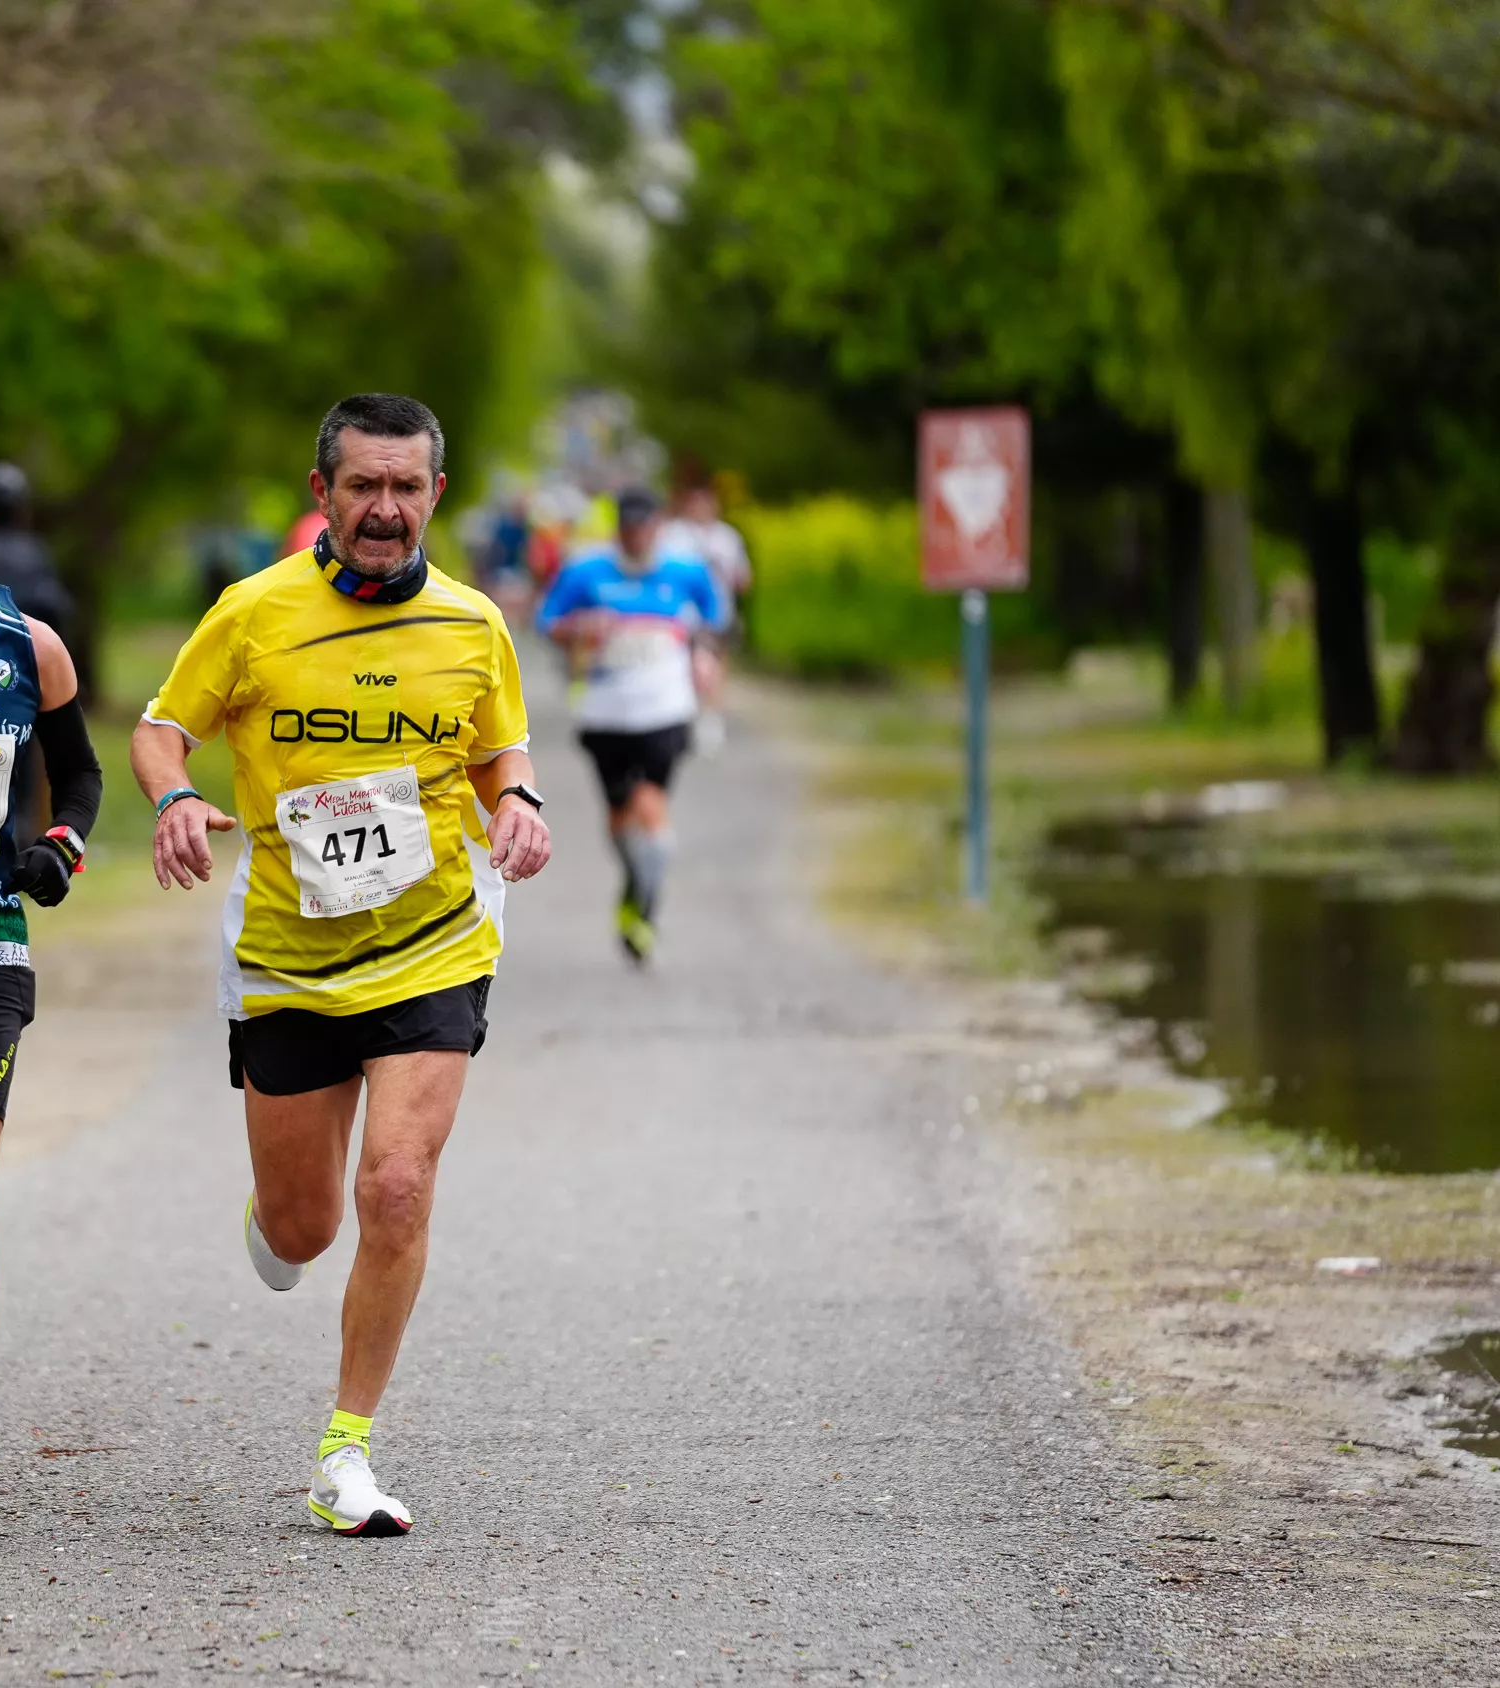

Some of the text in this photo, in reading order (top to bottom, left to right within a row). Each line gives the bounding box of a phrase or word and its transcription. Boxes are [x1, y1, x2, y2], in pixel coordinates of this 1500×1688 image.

[353, 672, 397, 686] vive
[333, 801, 377, 817] LUCENA
[321, 823, 397, 867] 471
[344, 869, 384, 882] MANUEL LIGERO
